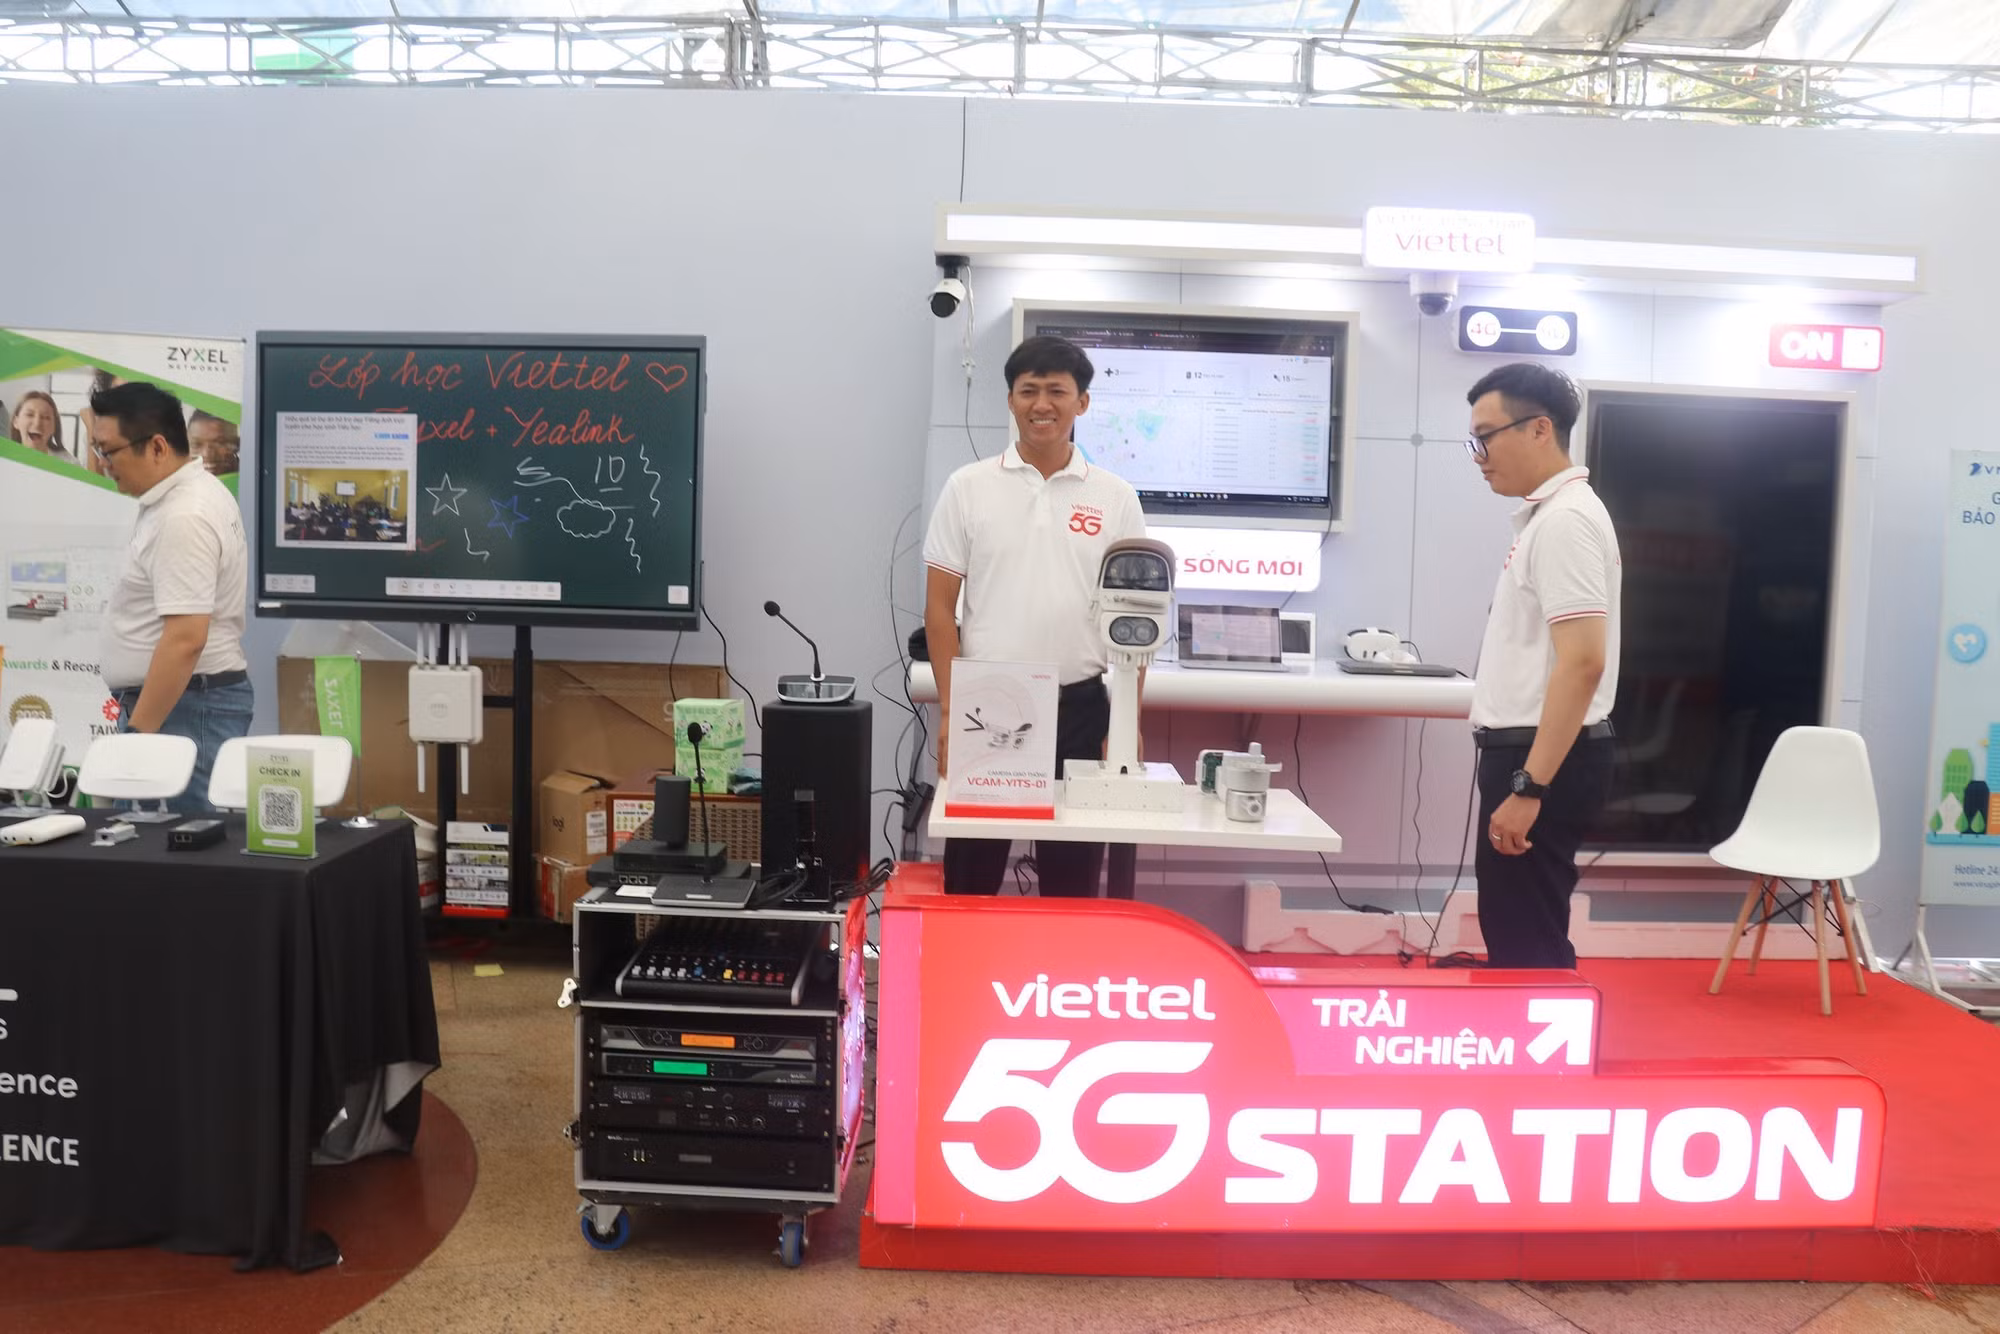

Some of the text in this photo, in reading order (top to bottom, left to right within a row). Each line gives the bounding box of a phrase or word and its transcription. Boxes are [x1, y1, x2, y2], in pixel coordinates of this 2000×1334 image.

[1396, 232, 1504, 254] viettel
[167, 346, 230, 364] ZYXEL
[1780, 331, 1833, 361] ON
[309, 352, 630, 400] Lớp học Viettel
[504, 406, 637, 447] Yealink
[1069, 512, 1102, 536] 5G
[3, 659, 48, 670] Awards
[52, 659, 61, 671] &
[259, 766, 301, 778] CHECK IN
[991, 974, 1216, 1022] viettel
[1312, 989, 1408, 1028] TRẢI
[1354, 1027, 1515, 1070] NGHIỆM
[940, 1038, 1864, 1205] 5G STATION
[0, 1134, 80, 1167] ENCE
